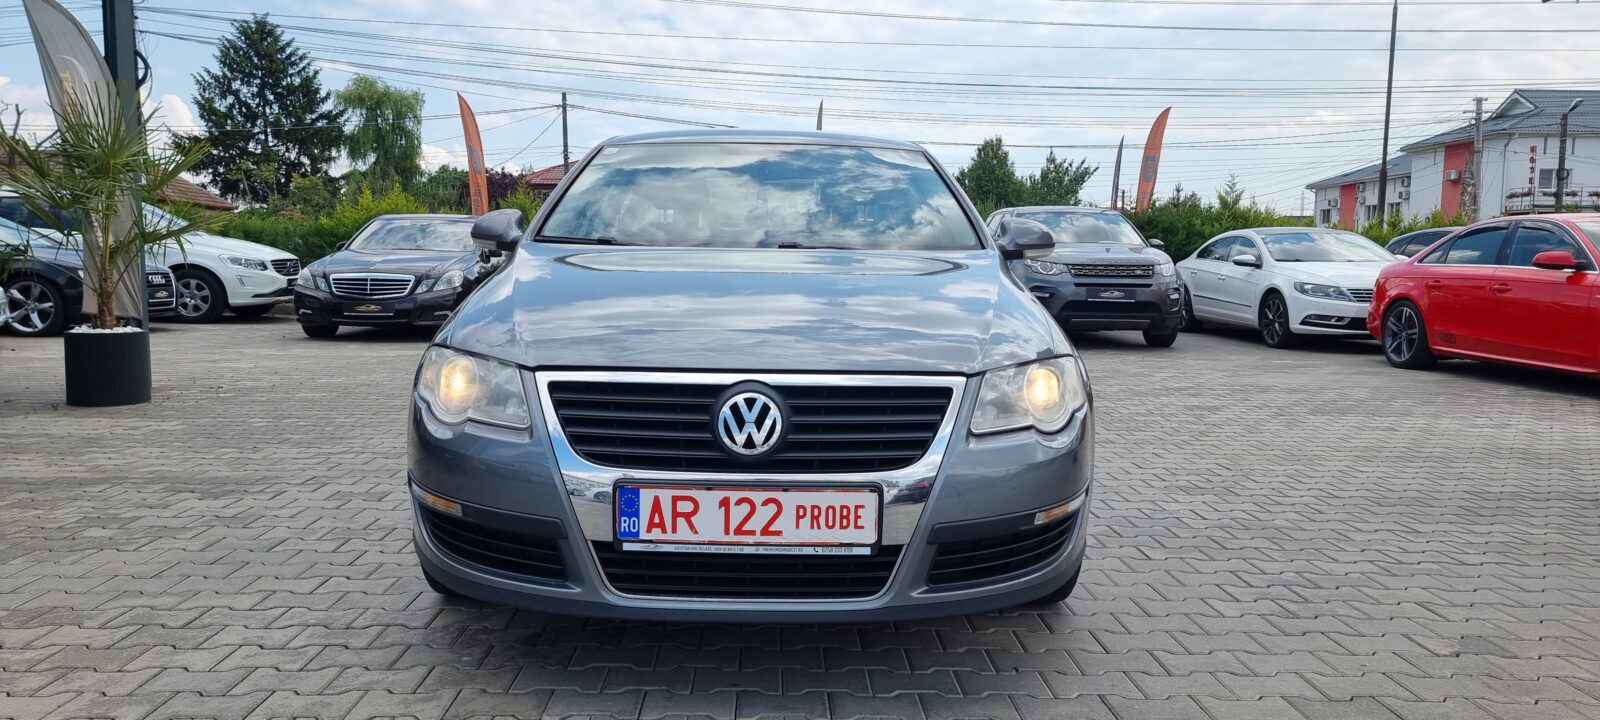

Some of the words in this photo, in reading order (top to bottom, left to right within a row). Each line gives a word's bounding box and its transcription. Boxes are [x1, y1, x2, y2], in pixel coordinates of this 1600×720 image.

[718, 392, 782, 456] VW
[621, 517, 639, 532] RO
[645, 495, 700, 535] AR
[718, 496, 784, 537] 122
[795, 504, 866, 530] PROBE
